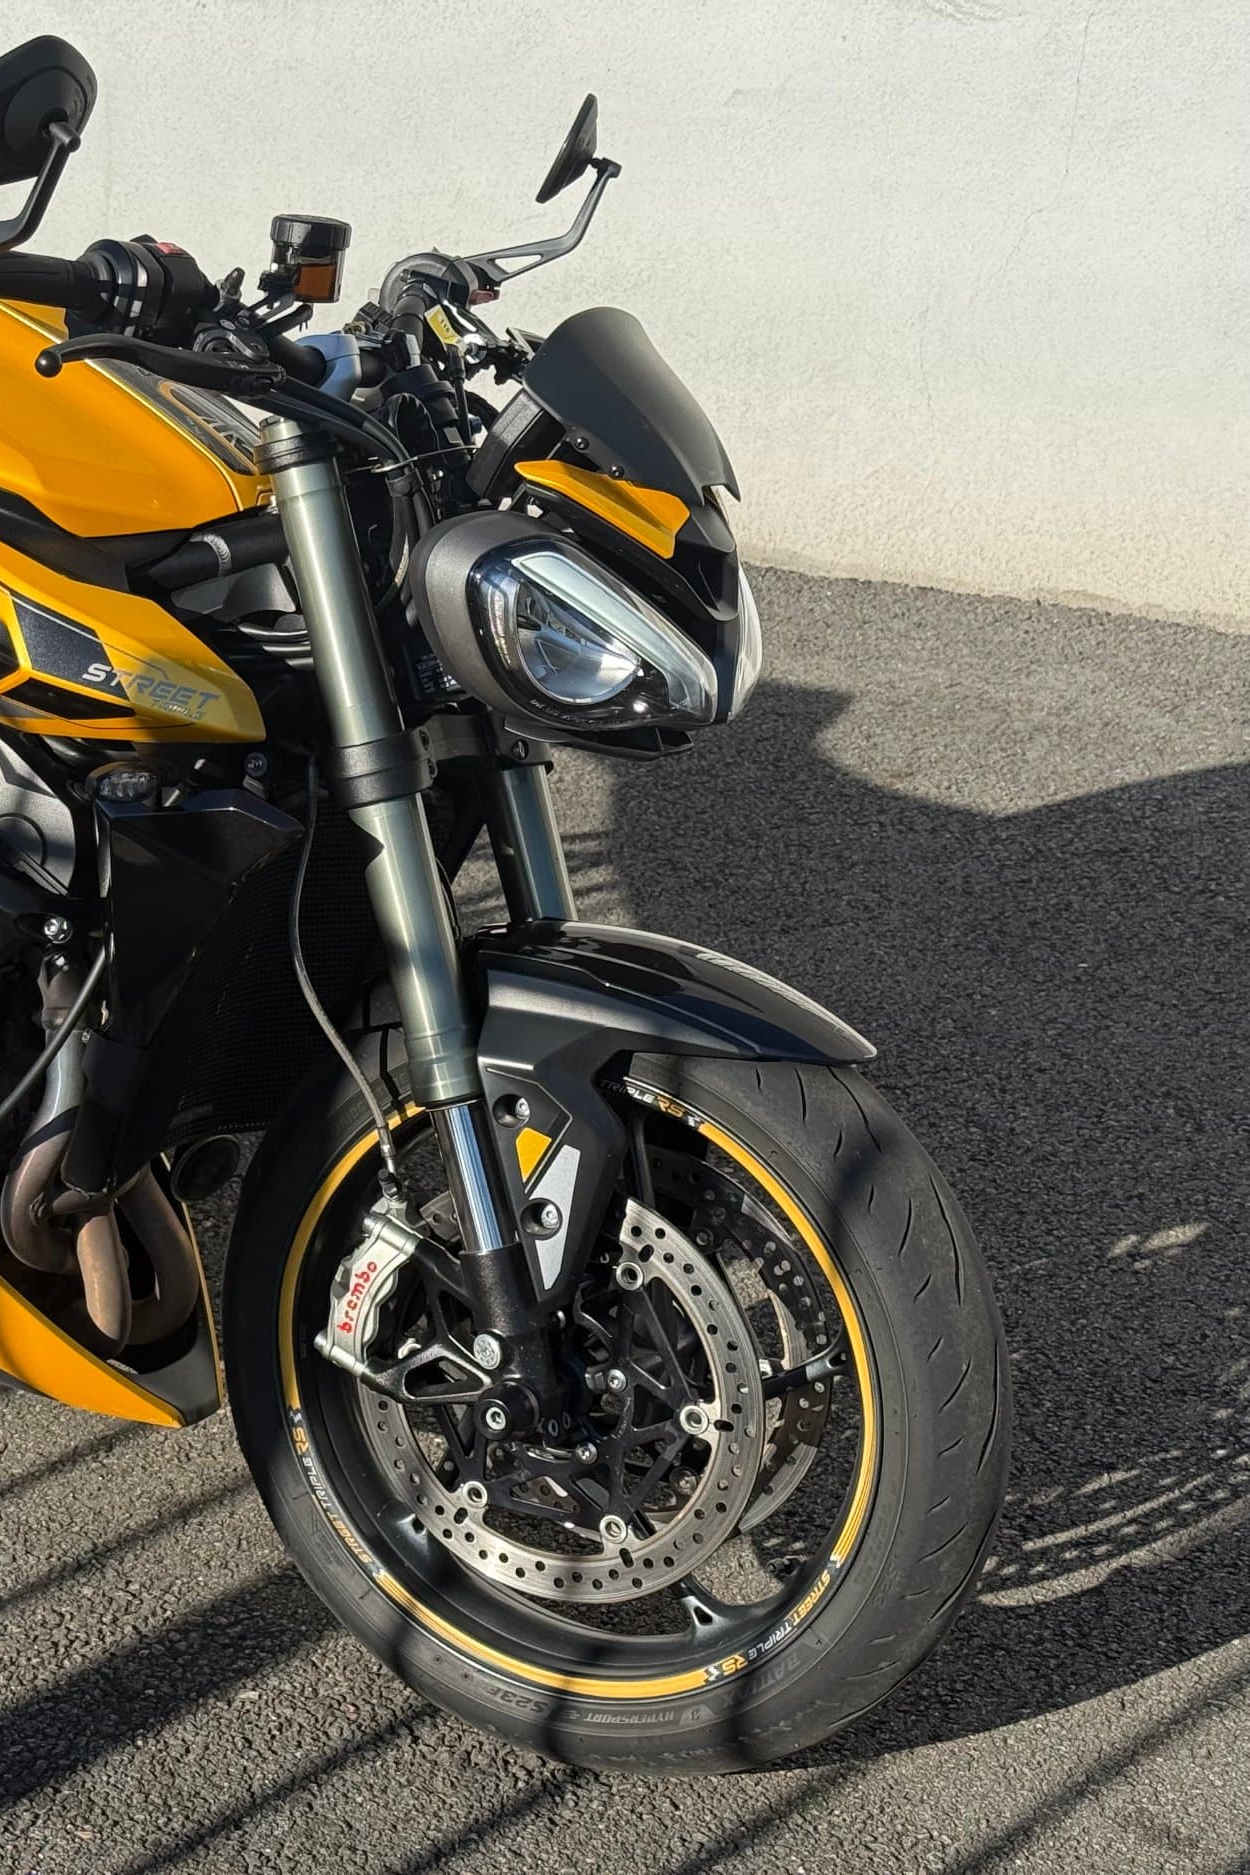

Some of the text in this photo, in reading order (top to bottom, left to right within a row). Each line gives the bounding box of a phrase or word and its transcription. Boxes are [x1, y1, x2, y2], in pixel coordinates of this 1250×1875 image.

[82, 663, 222, 709] STREET
[657, 1095, 686, 1118] RS
[336, 1261, 377, 1334] brembo
[292, 1426, 310, 1456] RS
[302, 1456, 332, 1509] TRIPLE
[327, 1510, 373, 1564] STREET
[792, 1569, 832, 1626] STREET
[748, 1621, 793, 1660] TRIPLE
[721, 1653, 749, 1677] RS
